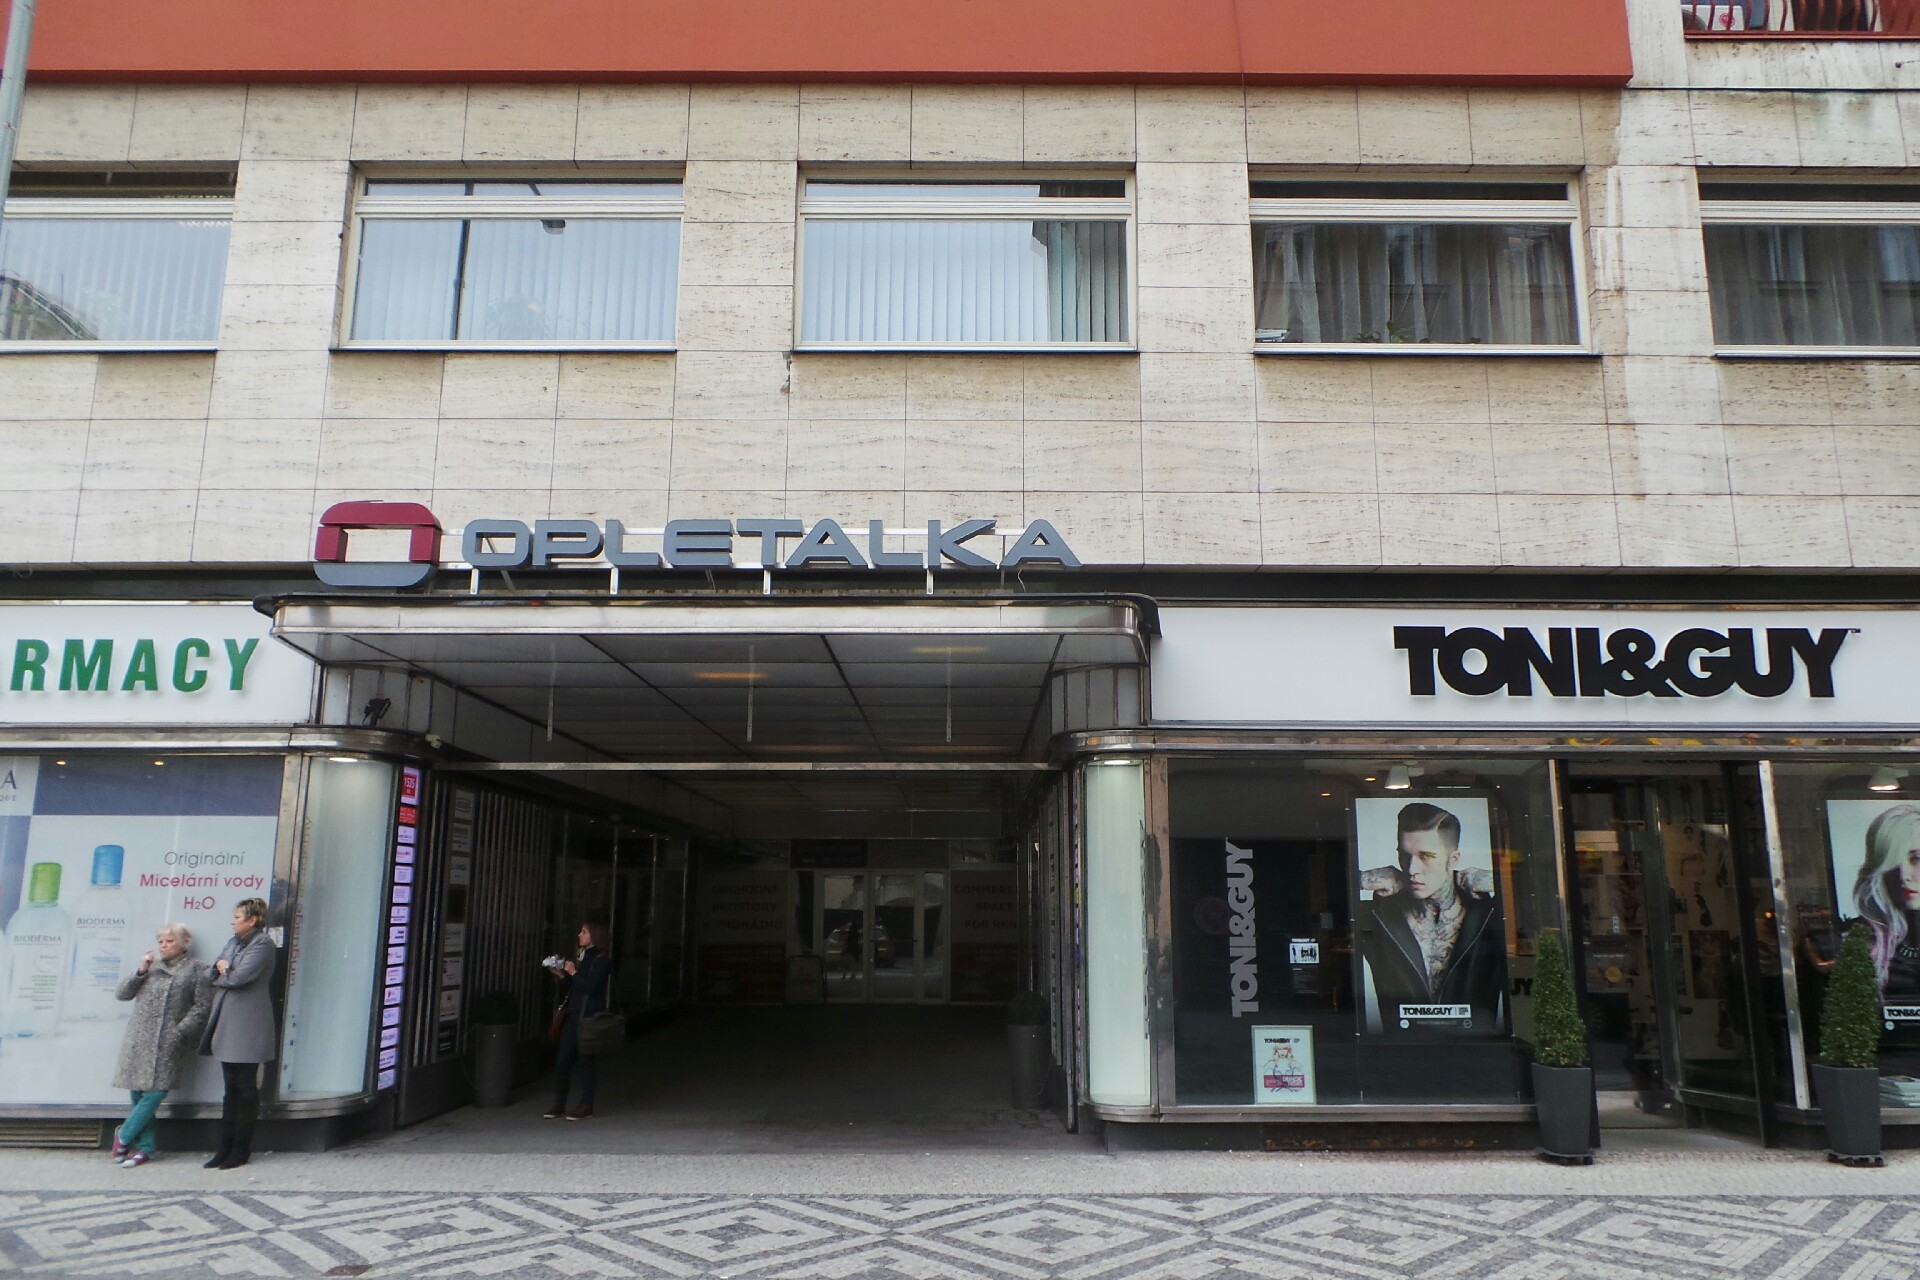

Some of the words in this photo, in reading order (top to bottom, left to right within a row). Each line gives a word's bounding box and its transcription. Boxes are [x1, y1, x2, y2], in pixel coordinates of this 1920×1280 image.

[462, 519, 1082, 568] OPLETALKA
[10, 637, 260, 693] RMACY
[1394, 626, 1850, 698] TONI&GUY
[164, 851, 246, 868] Originální
[140, 873, 219, 888] Micelární
[224, 874, 264, 891] vody
[976, 902, 1014, 912] SPACE
[76, 917, 125, 926] BIODERMA
[993, 920, 1018, 929] REN
[1226, 839, 1259, 1017] TONI&GUY
[14, 934, 63, 943] BIODERMA
[1402, 1007, 1453, 1016] TONI&GUY
